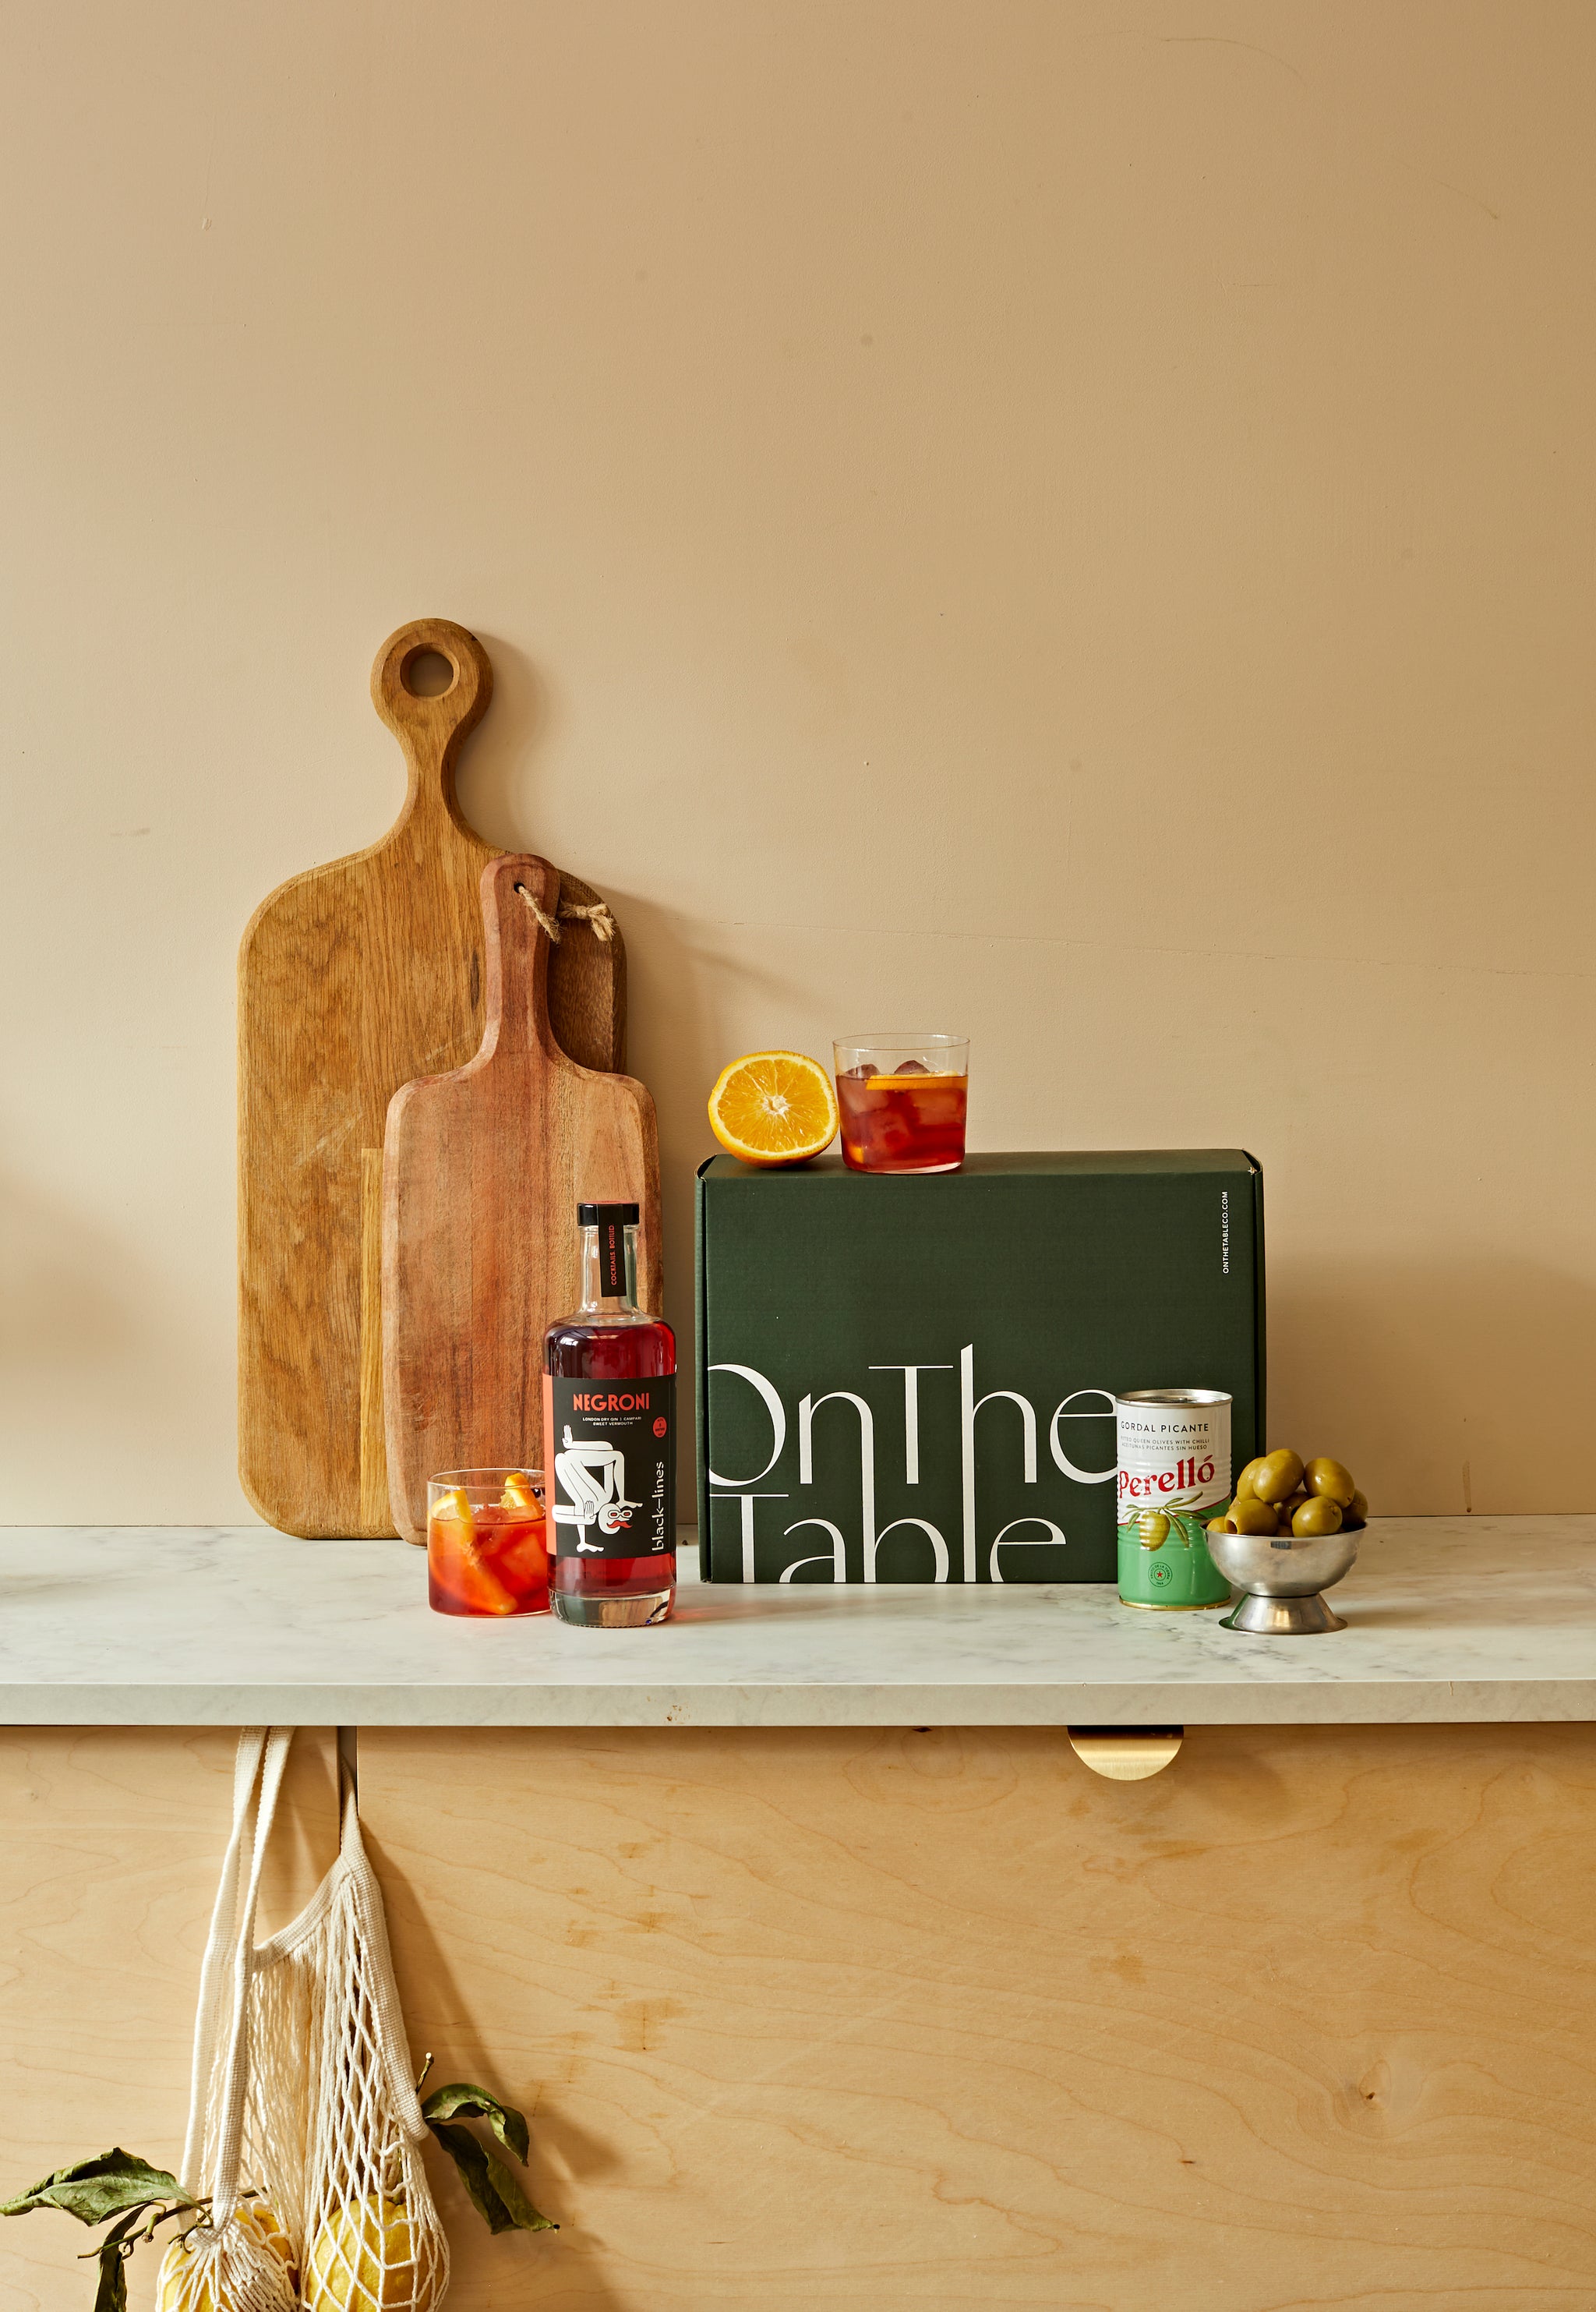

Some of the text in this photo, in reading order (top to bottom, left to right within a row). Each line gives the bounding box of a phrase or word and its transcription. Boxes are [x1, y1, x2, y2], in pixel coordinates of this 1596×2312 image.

[1221, 1191, 1230, 1274] ONTHETABLECO.COM
[573, 1392, 650, 1412] NEGRONI
[1121, 1421, 1209, 1433] GORDAL PICANTE
[1119, 1455, 1215, 1498] Perelló
